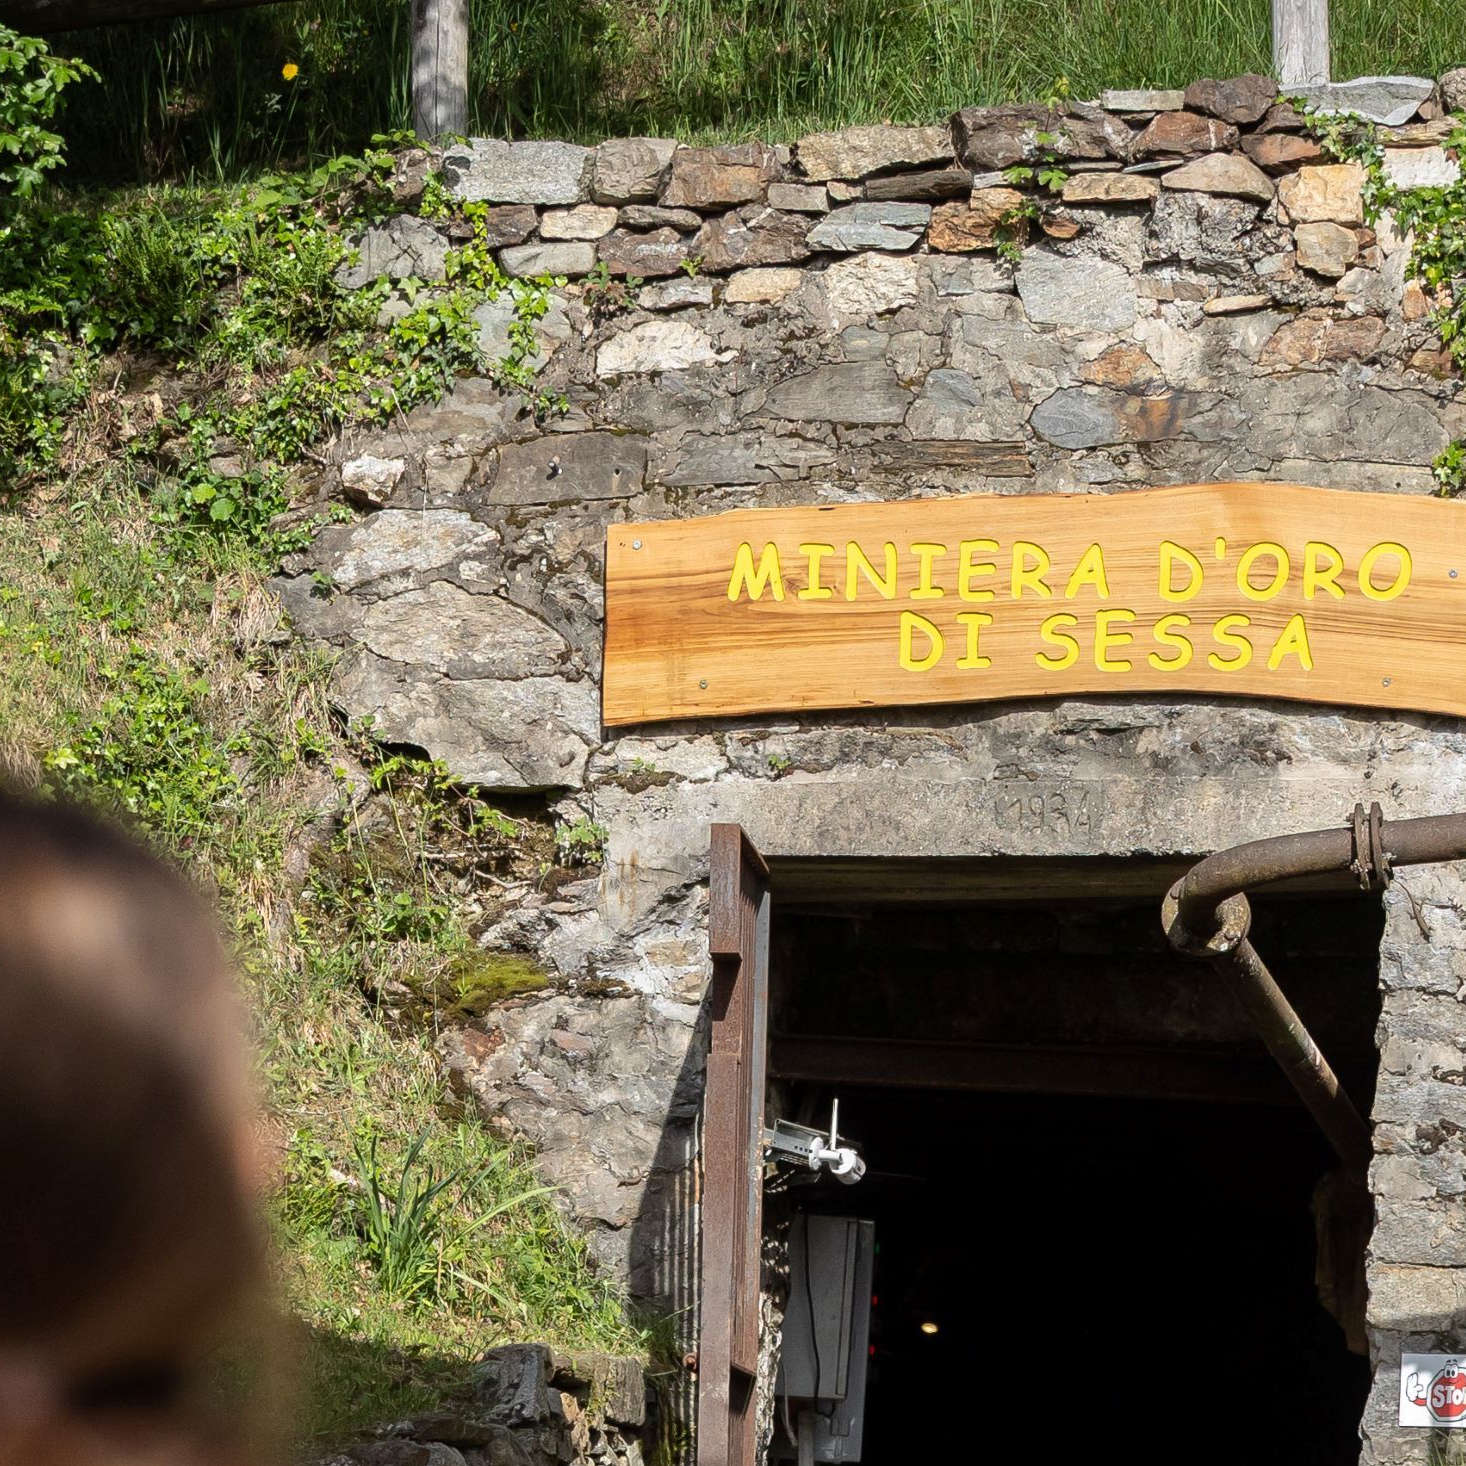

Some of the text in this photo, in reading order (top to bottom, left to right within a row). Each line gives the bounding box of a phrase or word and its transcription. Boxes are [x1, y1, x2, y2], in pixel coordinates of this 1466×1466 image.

[727, 536, 1413, 603] MINIERA D'ORO
[899, 609, 1313, 673] DI SESSA
